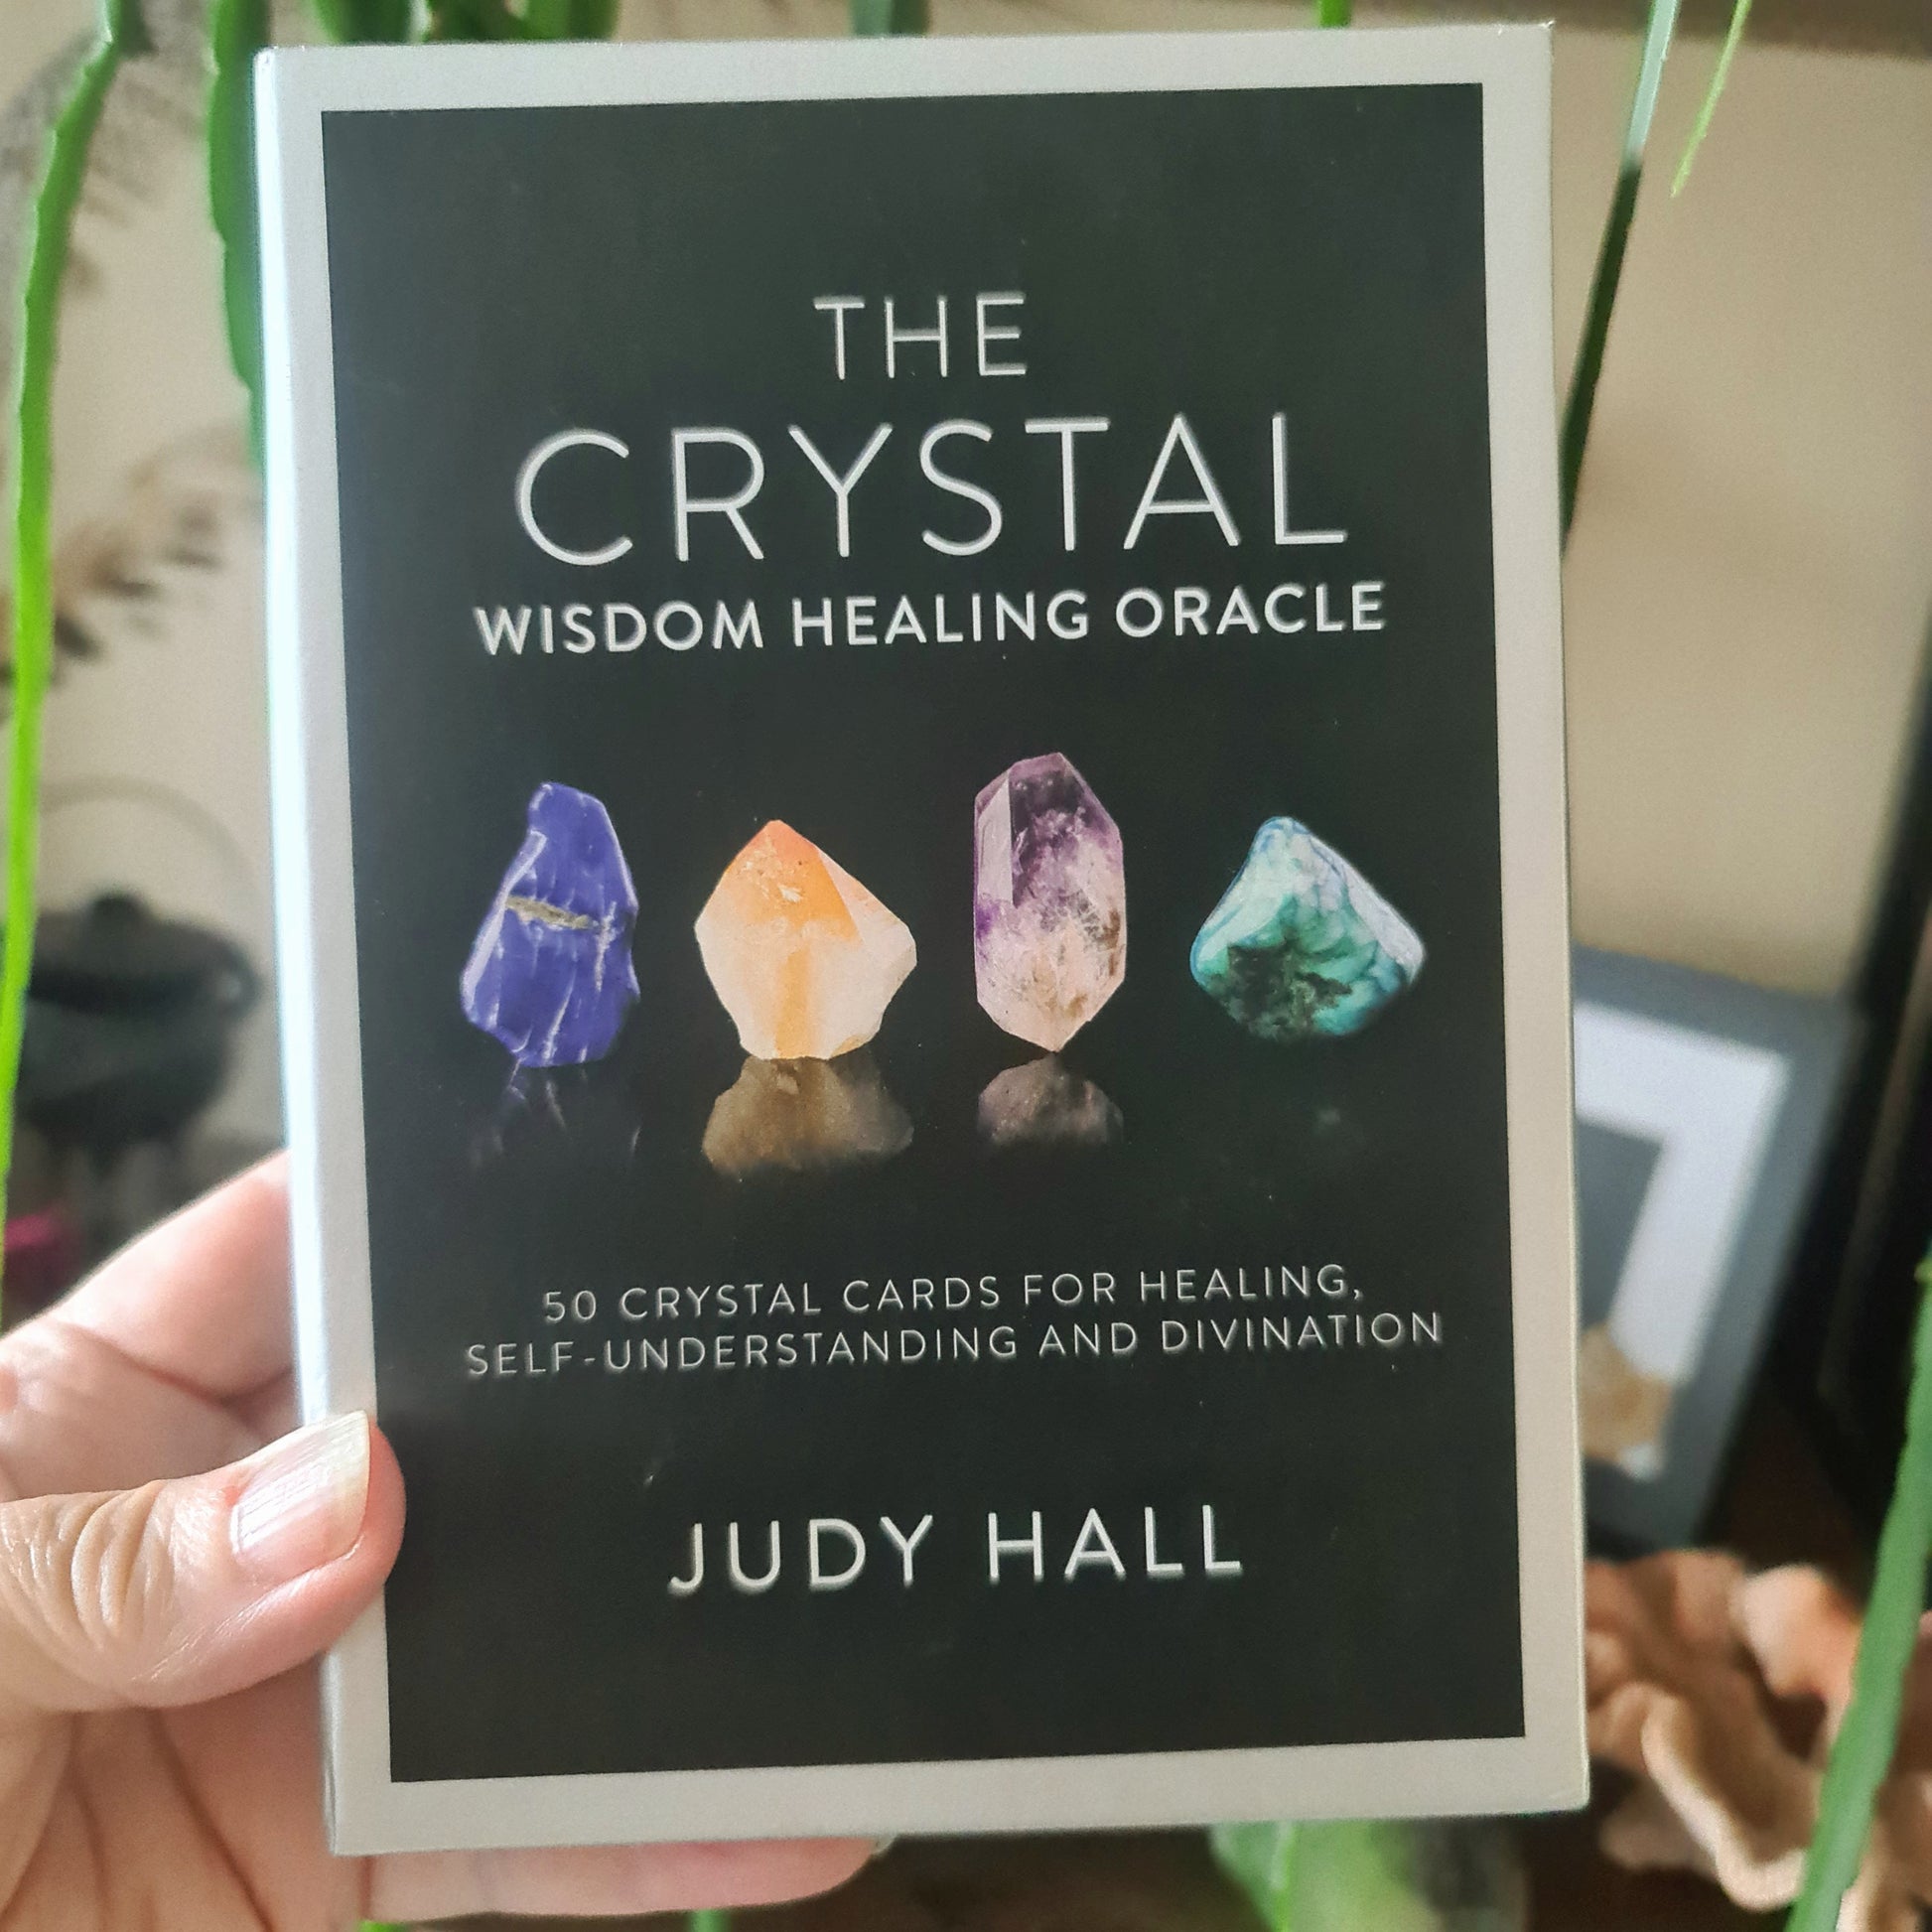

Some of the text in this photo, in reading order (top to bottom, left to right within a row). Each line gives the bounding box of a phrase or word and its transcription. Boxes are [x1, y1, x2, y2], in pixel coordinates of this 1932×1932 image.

[814, 292, 1026, 379] THE
[515, 412, 1347, 566] CRYSTAL
[473, 581, 1384, 655] WISDOM HEALING ORACLE
[544, 1264, 1364, 1322] 50 CRYSTAL CARDS FOR HEALING,
[466, 1312, 1440, 1376] SELF-UNDERSTANDING AND DIVINATION
[670, 1505, 1242, 1593] JUDY HALL
